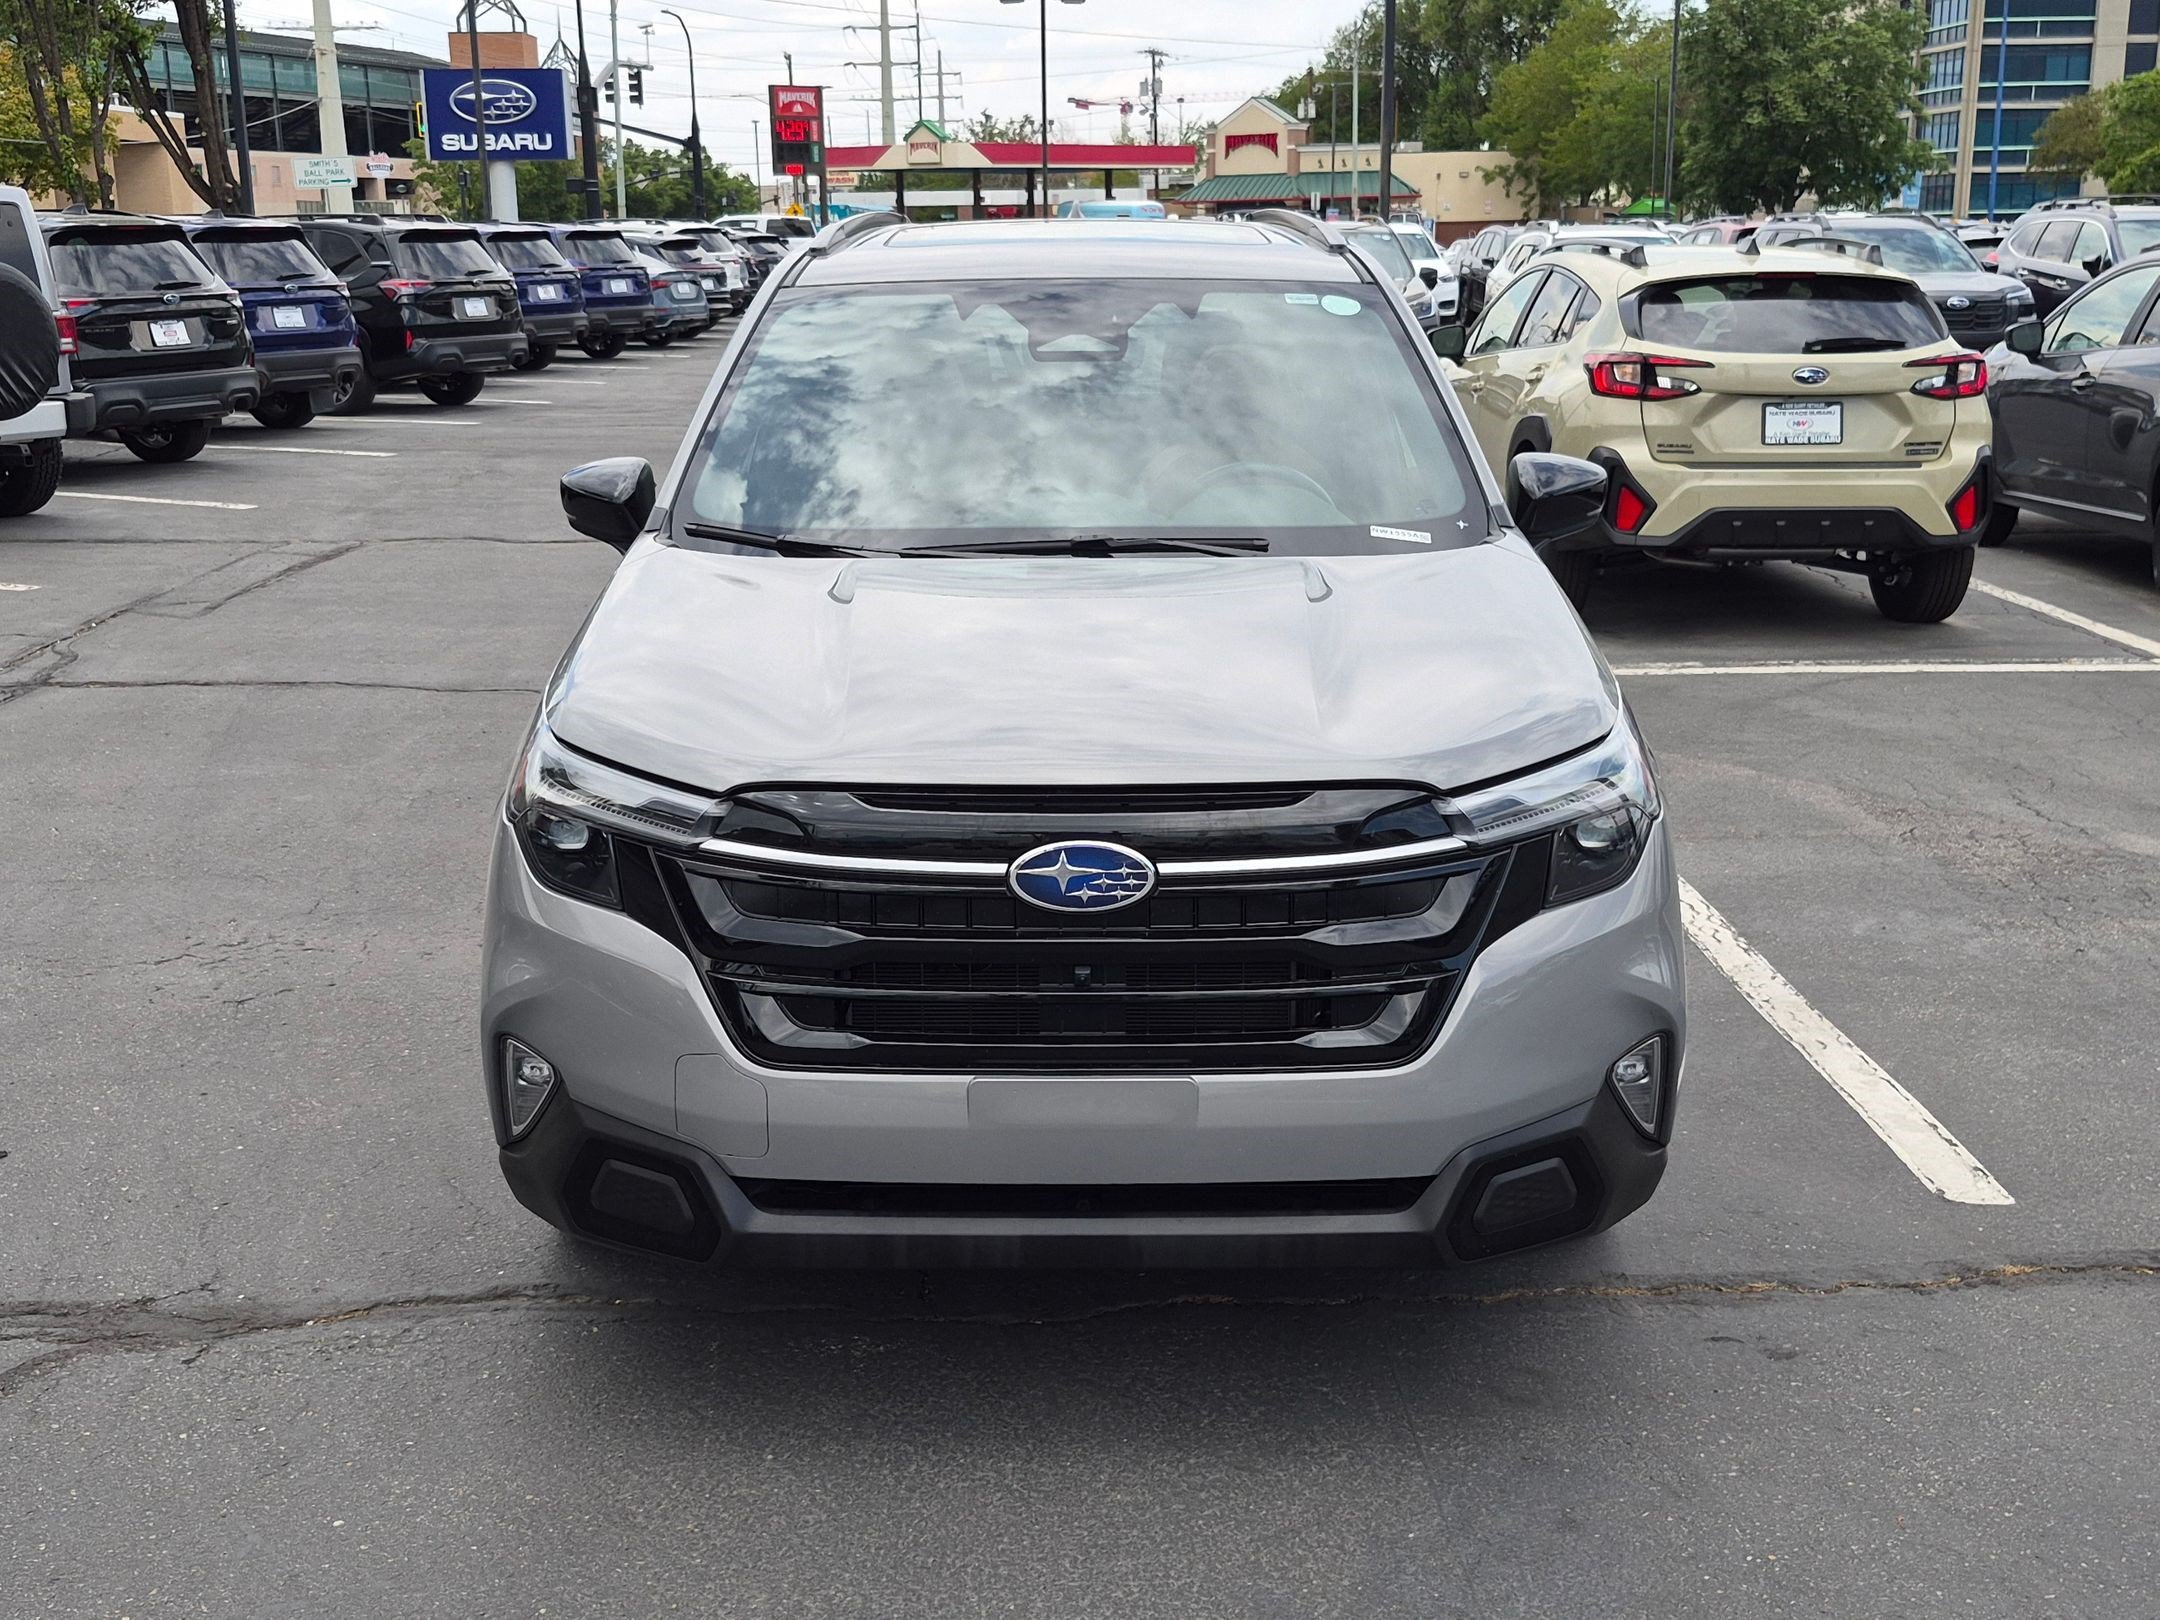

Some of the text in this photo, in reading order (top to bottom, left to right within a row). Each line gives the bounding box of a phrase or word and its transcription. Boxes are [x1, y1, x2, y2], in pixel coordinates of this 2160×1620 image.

[778, 91, 816, 108] MAVERIK
[441, 133, 553, 151] SUBARU
[909, 142, 939, 156] MAVERIK
[298, 178, 330, 186] PARKING
